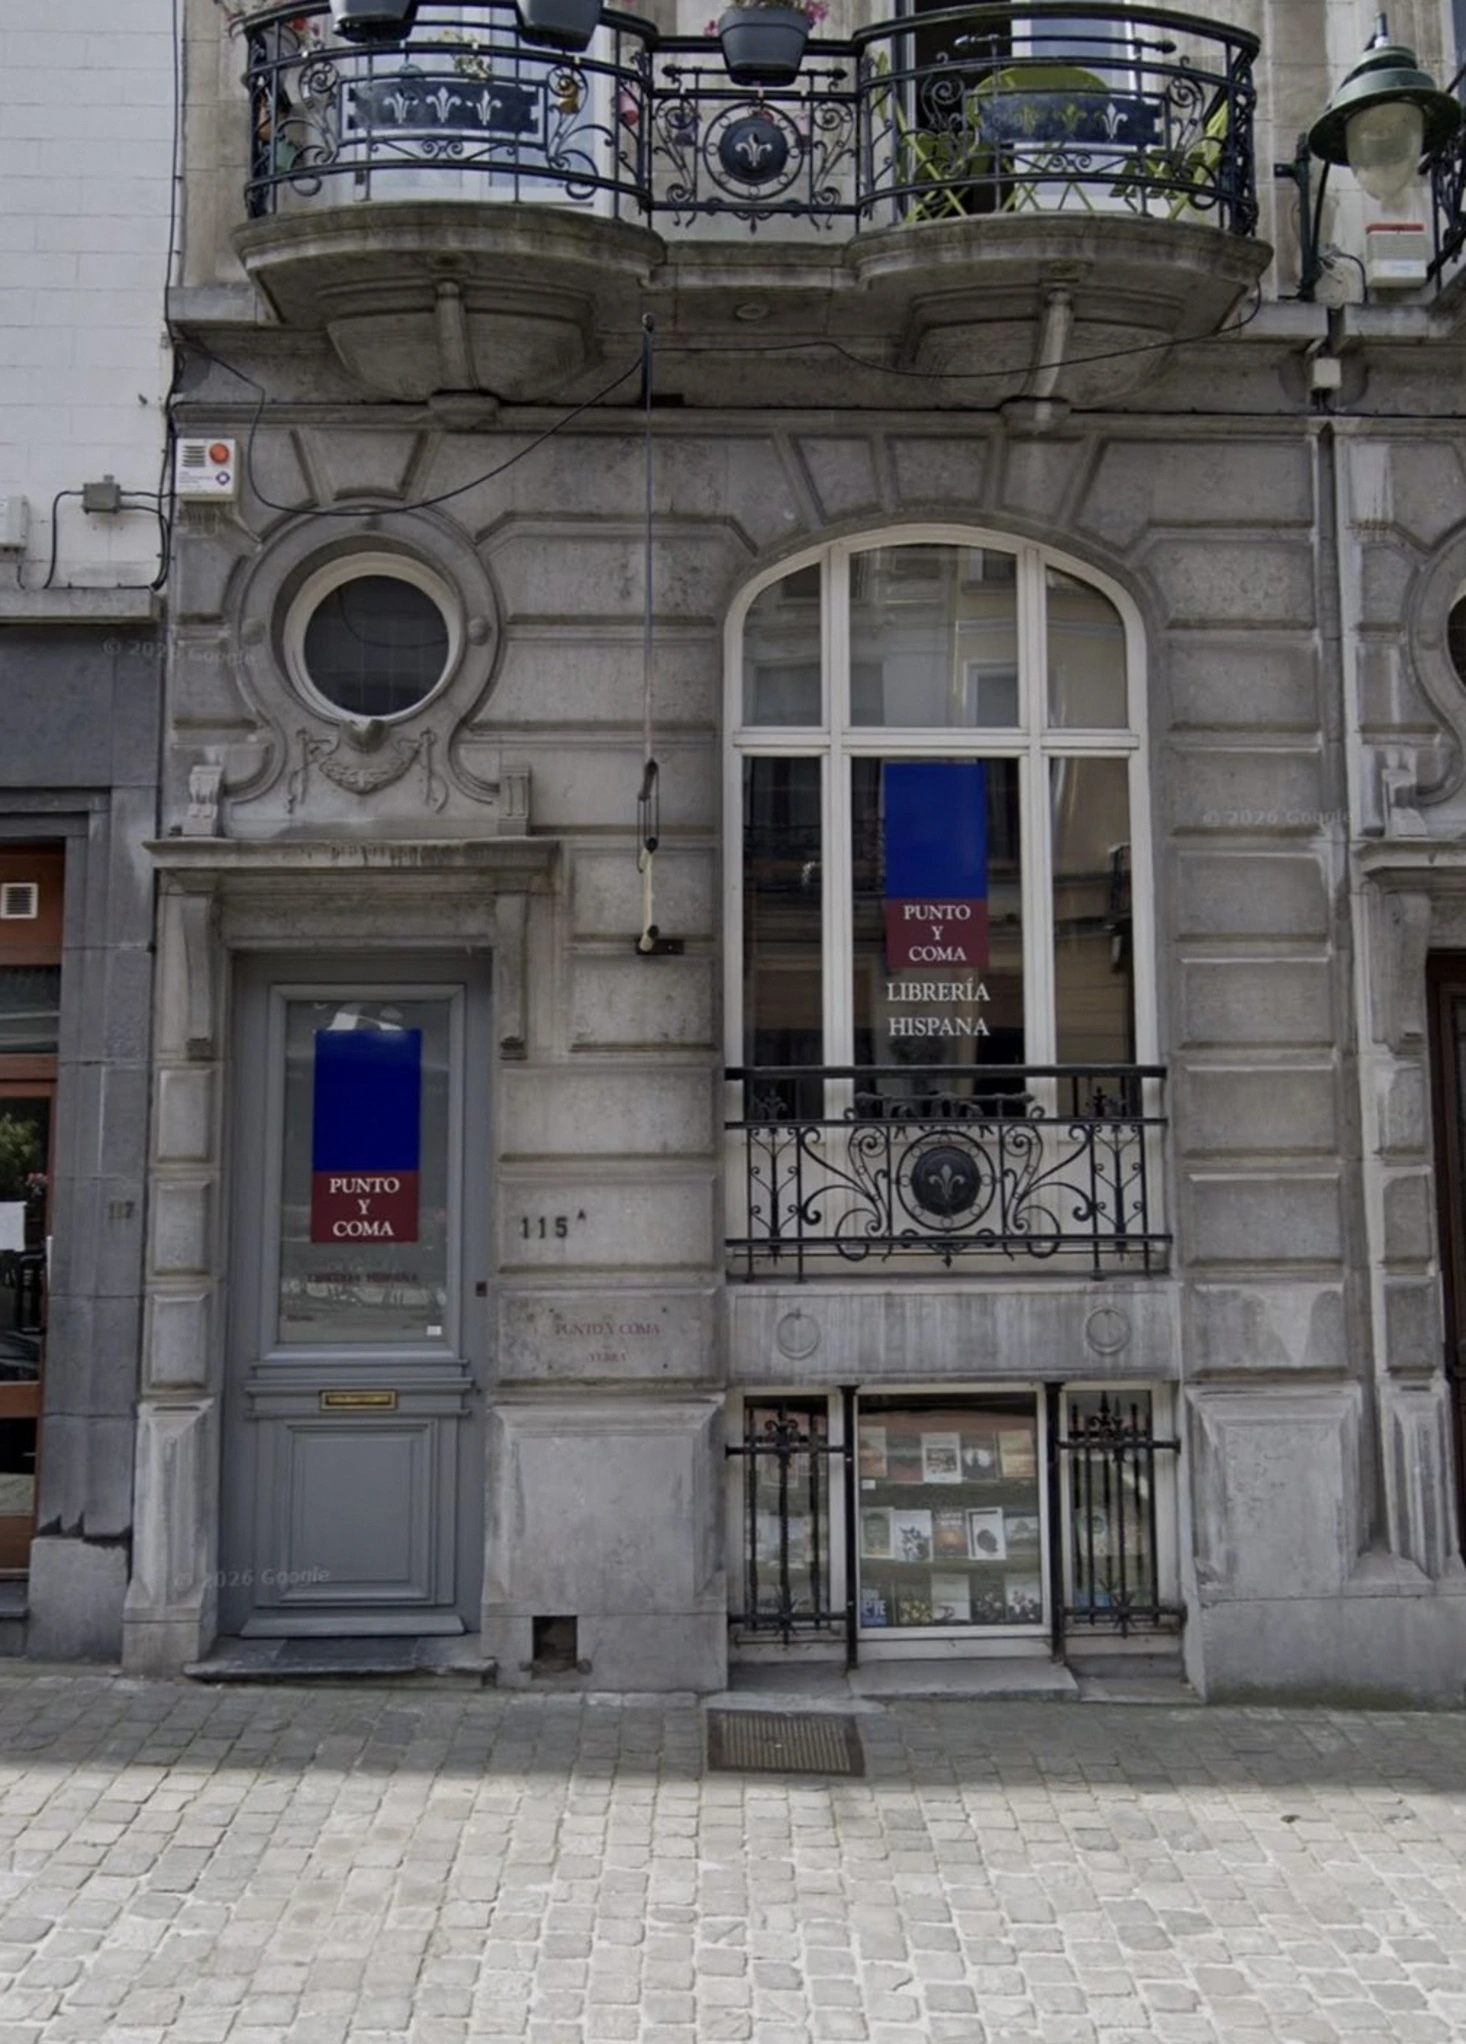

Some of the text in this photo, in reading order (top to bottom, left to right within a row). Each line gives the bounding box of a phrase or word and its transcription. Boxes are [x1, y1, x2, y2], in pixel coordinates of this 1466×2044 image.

[904, 904, 971, 920] PUNTO
[931, 925, 944, 940] Y
[909, 946, 967, 962] COMA
[887, 977, 991, 1001] LIBRERÍA
[889, 1017, 990, 1037] HISPANA
[329, 1177, 401, 1194] PUNTO
[357, 1199, 371, 1215] Y
[333, 1221, 395, 1237] COMA
